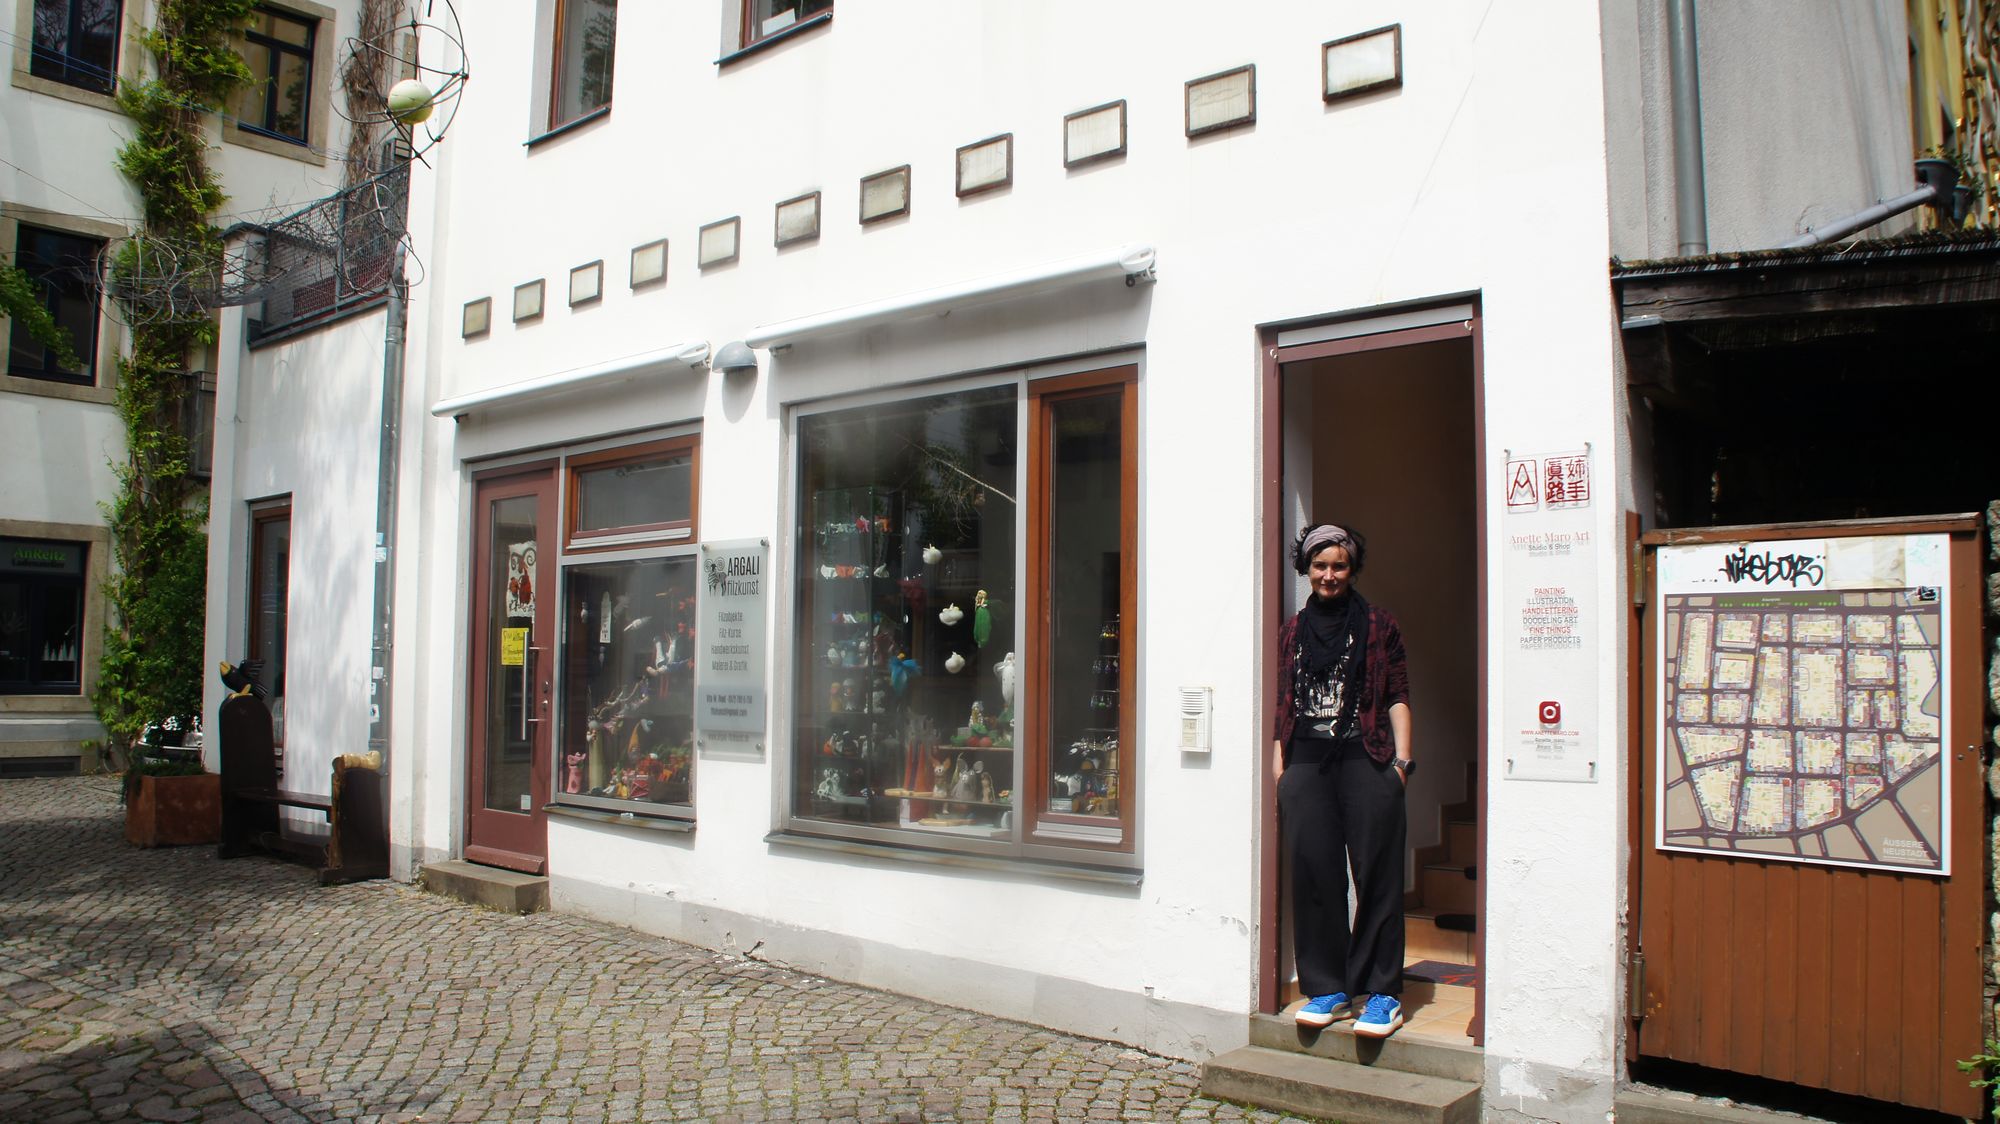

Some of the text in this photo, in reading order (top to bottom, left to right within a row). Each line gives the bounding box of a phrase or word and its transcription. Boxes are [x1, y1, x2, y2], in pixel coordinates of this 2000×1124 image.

[1510, 531, 1590, 544] Anette Maro Art
[728, 555, 760, 577] ARGALI
[727, 579, 760, 596] filzkunst
[1534, 587, 1566, 595] PAINTING
[1527, 597, 1574, 605] ILLUSTRATION
[1522, 606, 1578, 615] HANDLETTERING
[1564, 616, 1578, 624] ART
[1530, 626, 1571, 634] FINE THINGS
[1520, 635, 1581, 644] PAPER PRODUCTS
[1883, 847, 1928, 858] NEUSTADT
